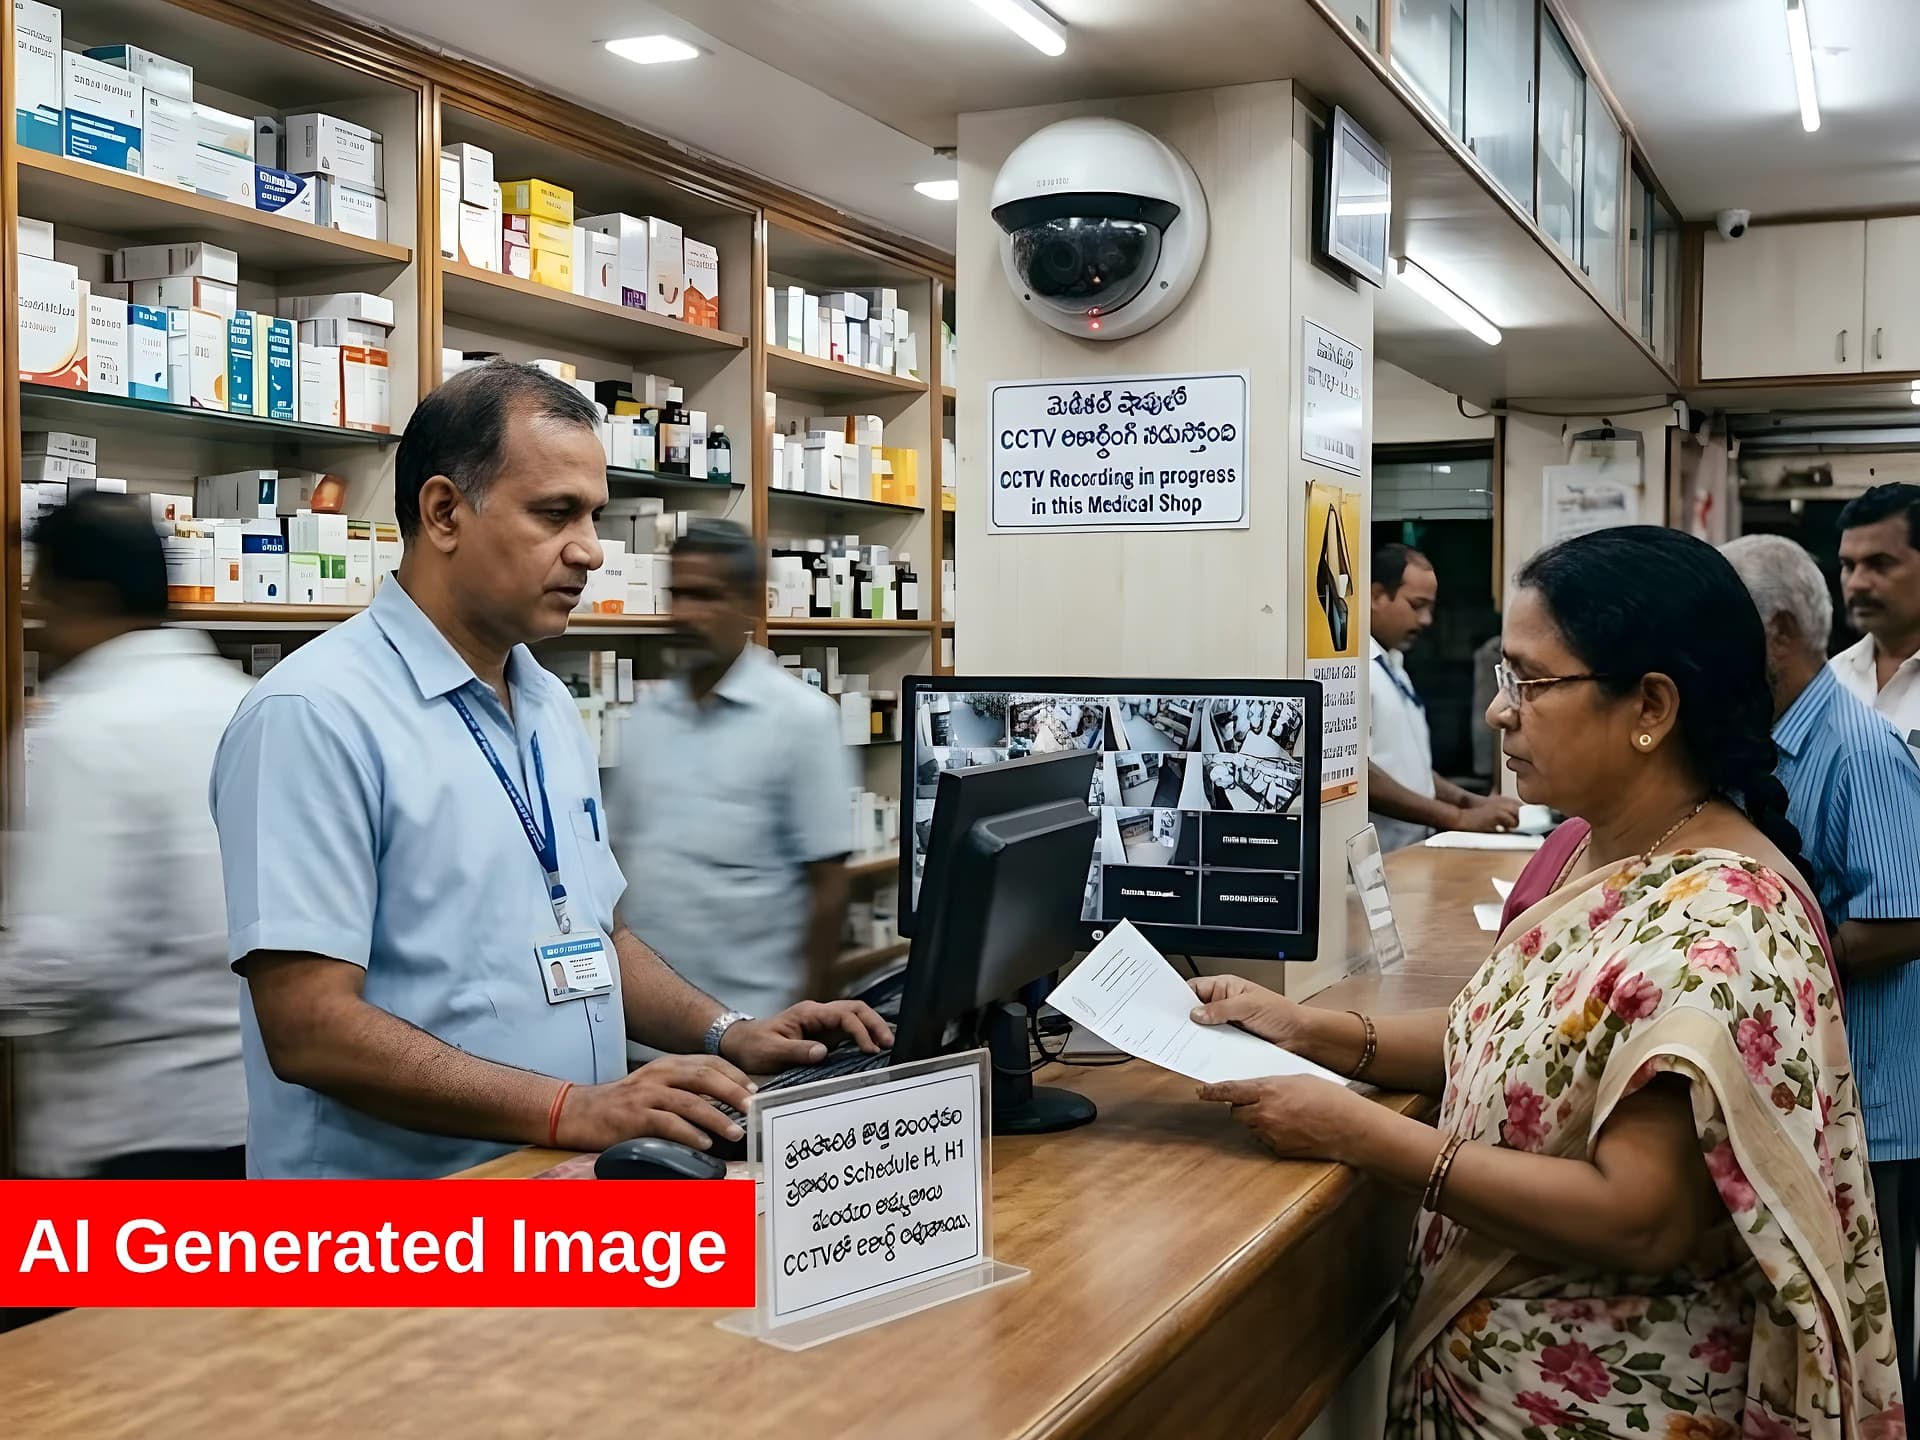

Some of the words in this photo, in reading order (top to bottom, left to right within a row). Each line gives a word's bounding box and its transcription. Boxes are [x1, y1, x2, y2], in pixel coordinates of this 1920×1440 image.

[1000, 428, 1057, 450] CCTV
[1000, 469, 1045, 490] CCTV
[1049, 467, 1134, 491] Recording
[1138, 466, 1155, 486] in
[1159, 468, 1236, 490] progress
[1031, 497, 1046, 515] in
[1051, 495, 1083, 515] this
[1088, 494, 1154, 514] Medical
[1159, 493, 1202, 516] Shop
[843, 1151, 920, 1187] Schedule
[924, 1145, 941, 1168] H,
[945, 1138, 964, 1162] H1
